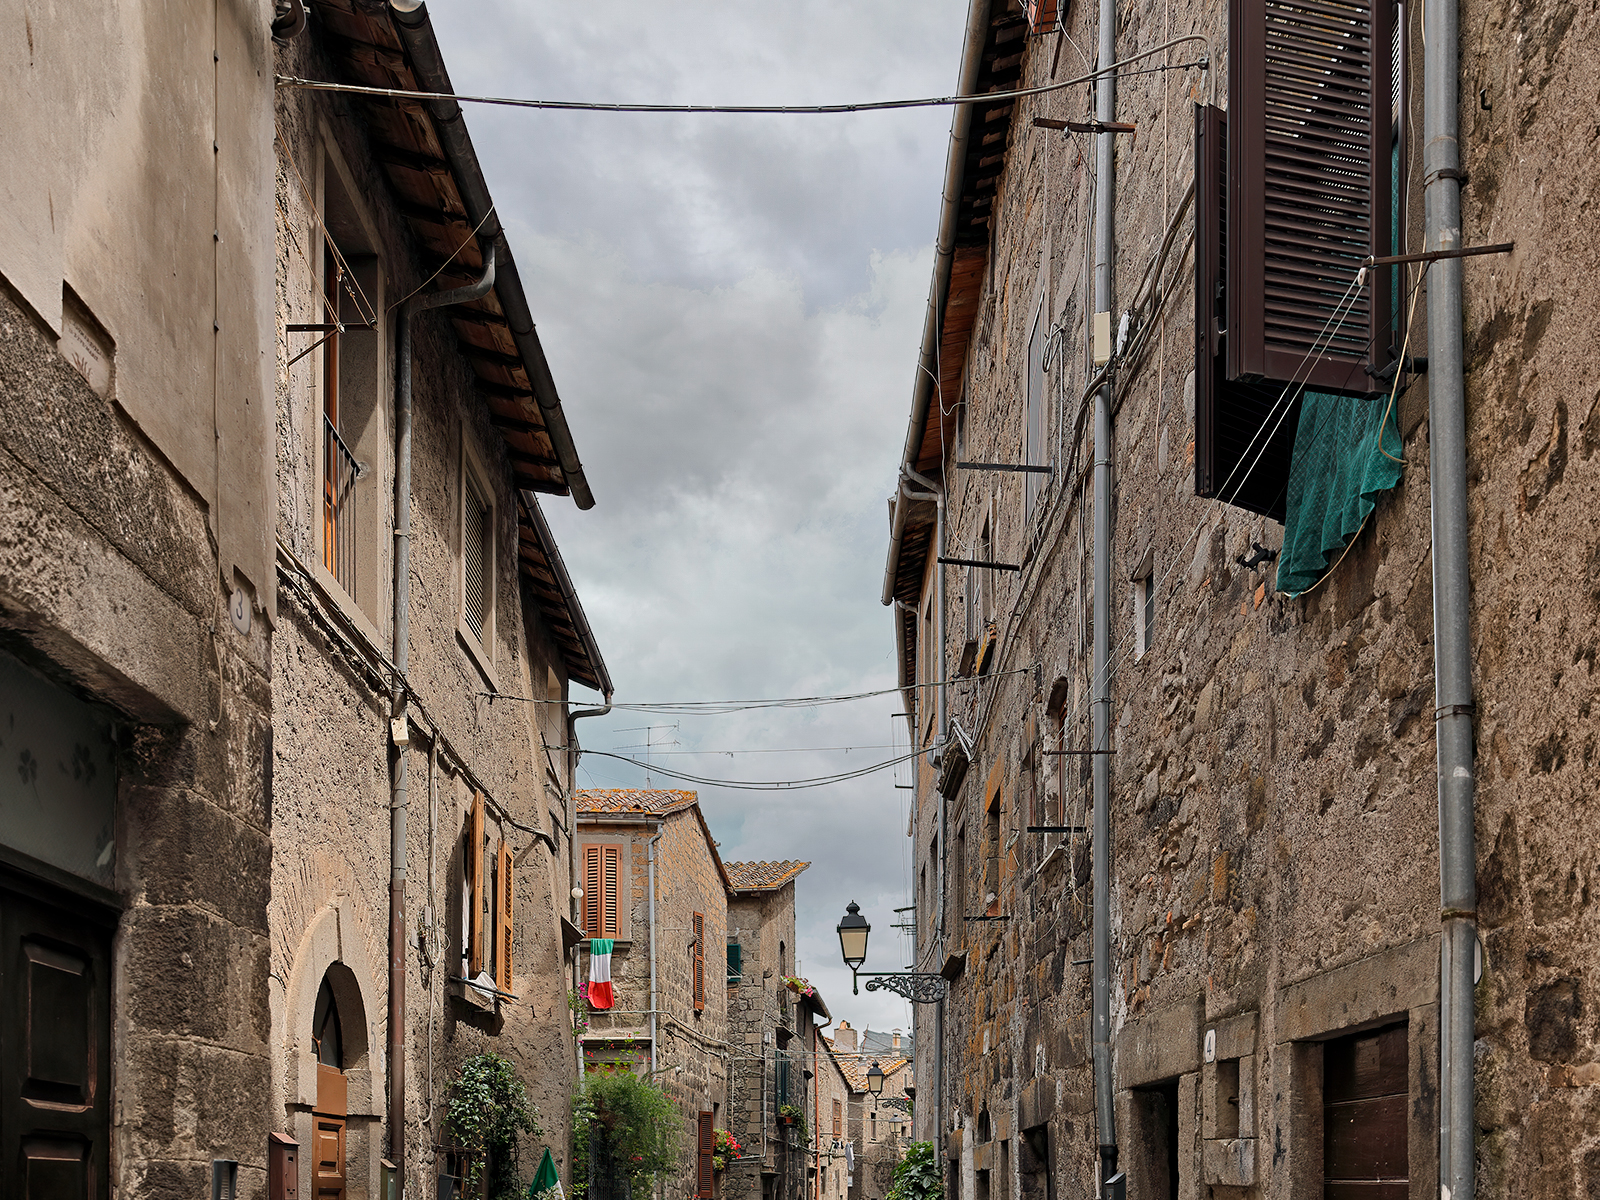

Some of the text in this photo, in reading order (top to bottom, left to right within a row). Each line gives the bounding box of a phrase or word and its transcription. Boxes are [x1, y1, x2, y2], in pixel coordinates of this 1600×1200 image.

[236, 588, 243, 621] 3
[371, 1022, 377, 1054] 5
[1207, 1036, 1212, 1056] 4
